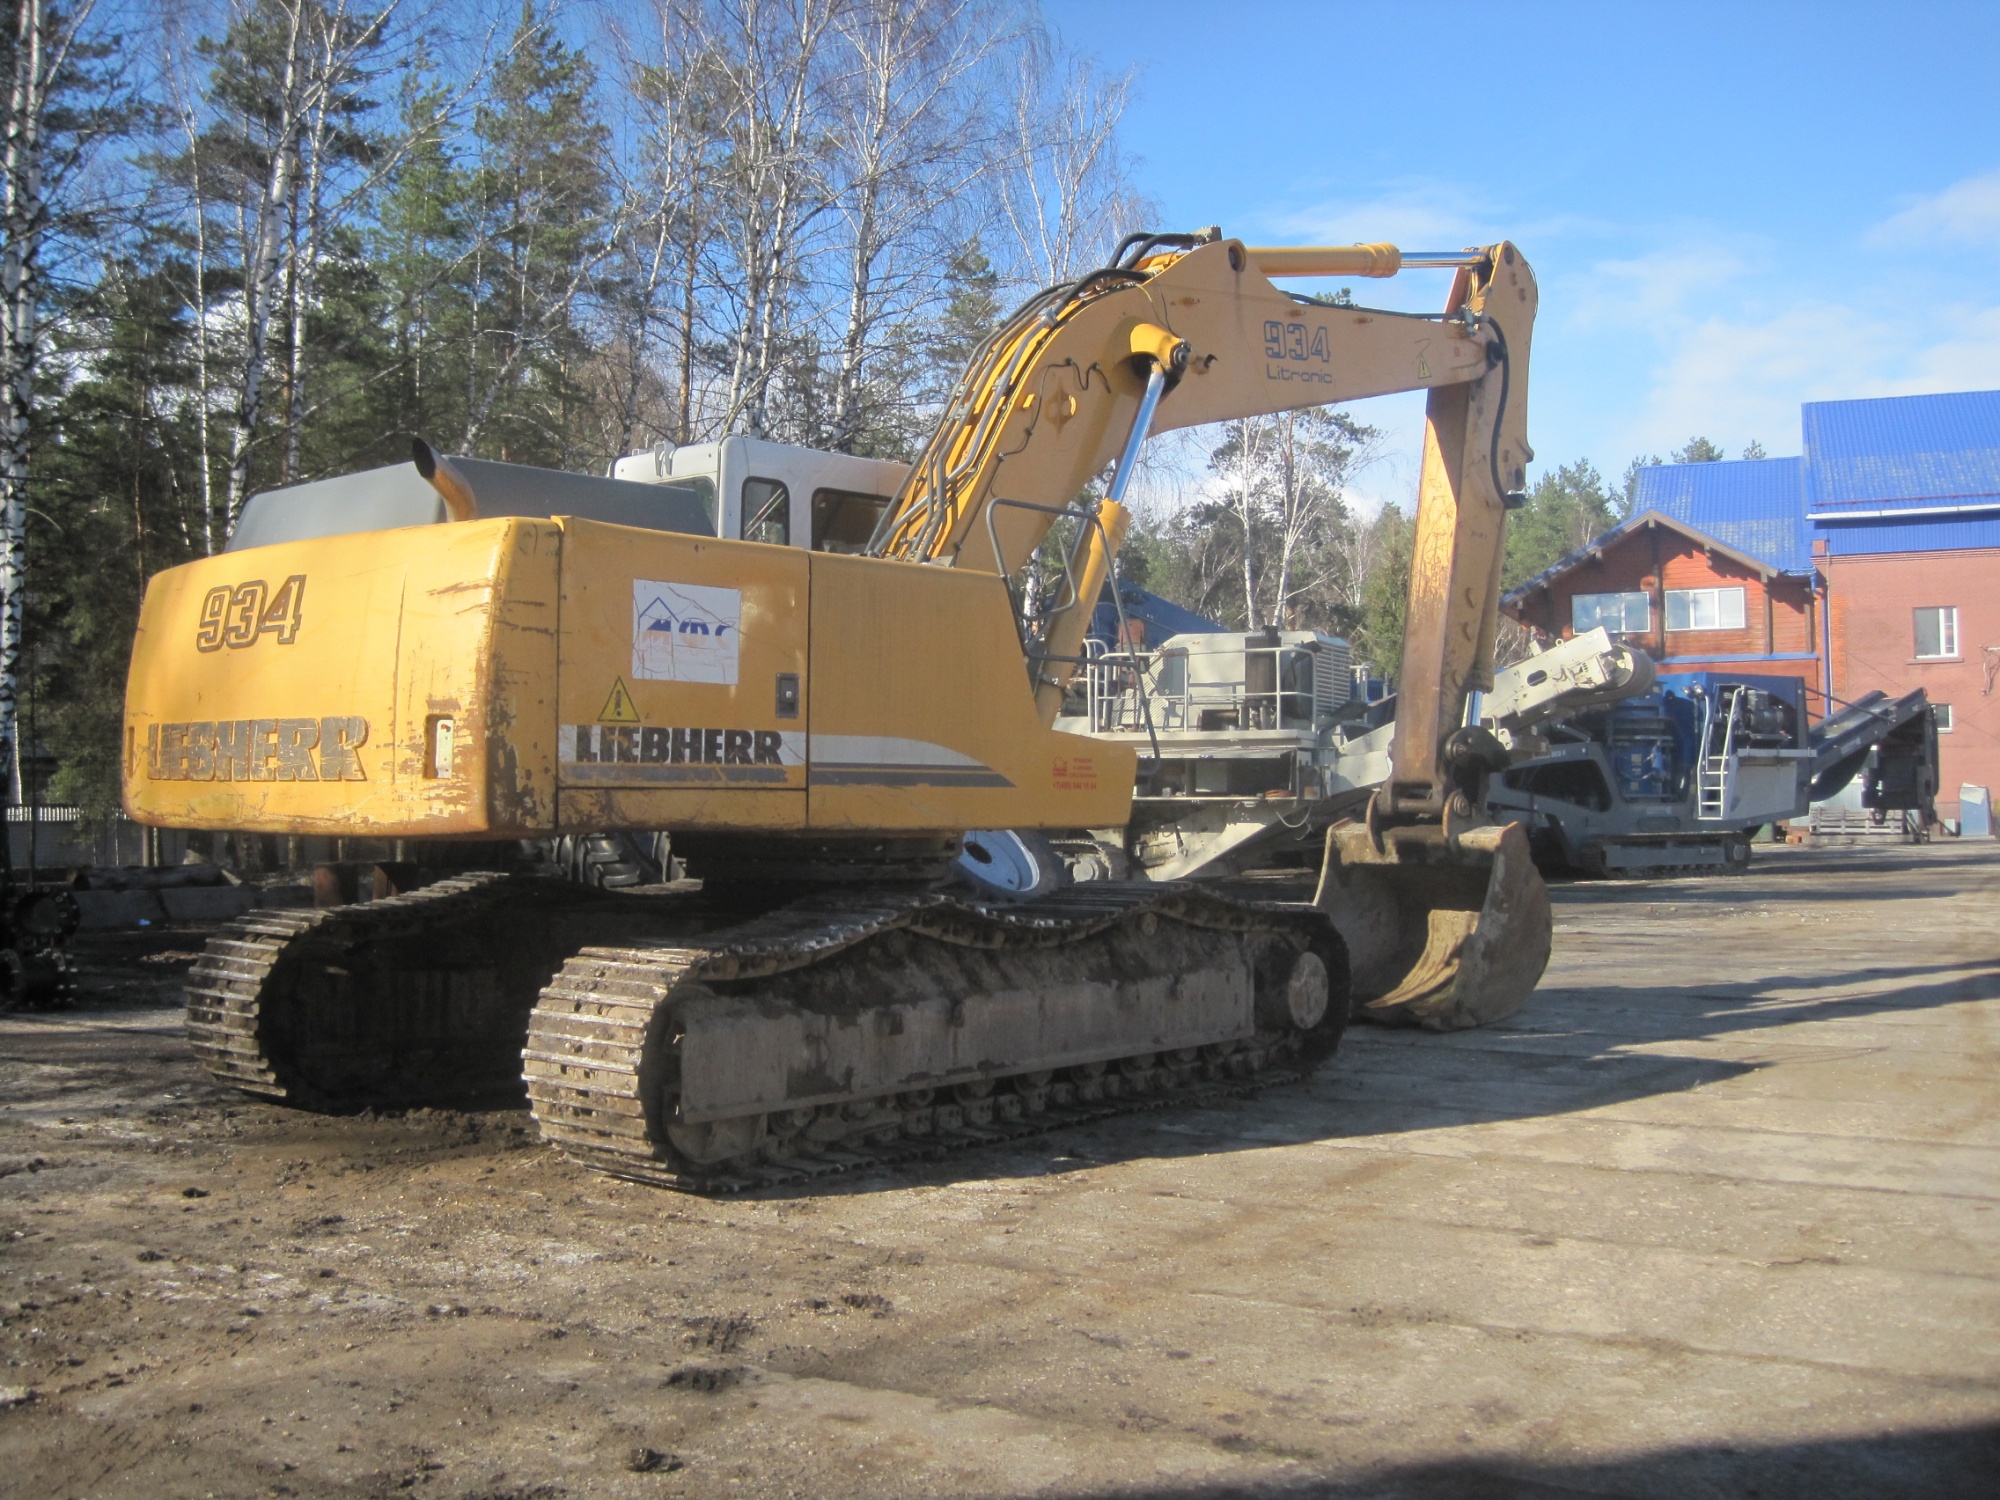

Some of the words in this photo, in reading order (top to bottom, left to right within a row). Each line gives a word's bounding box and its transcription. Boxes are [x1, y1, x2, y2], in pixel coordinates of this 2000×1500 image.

[1263, 320, 1331, 363] 934
[1266, 363, 1333, 384] Litronic
[196, 574, 307, 652] 934
[147, 716, 370, 781] LIEBHERR
[576, 726, 782, 765] LIEBHERR
